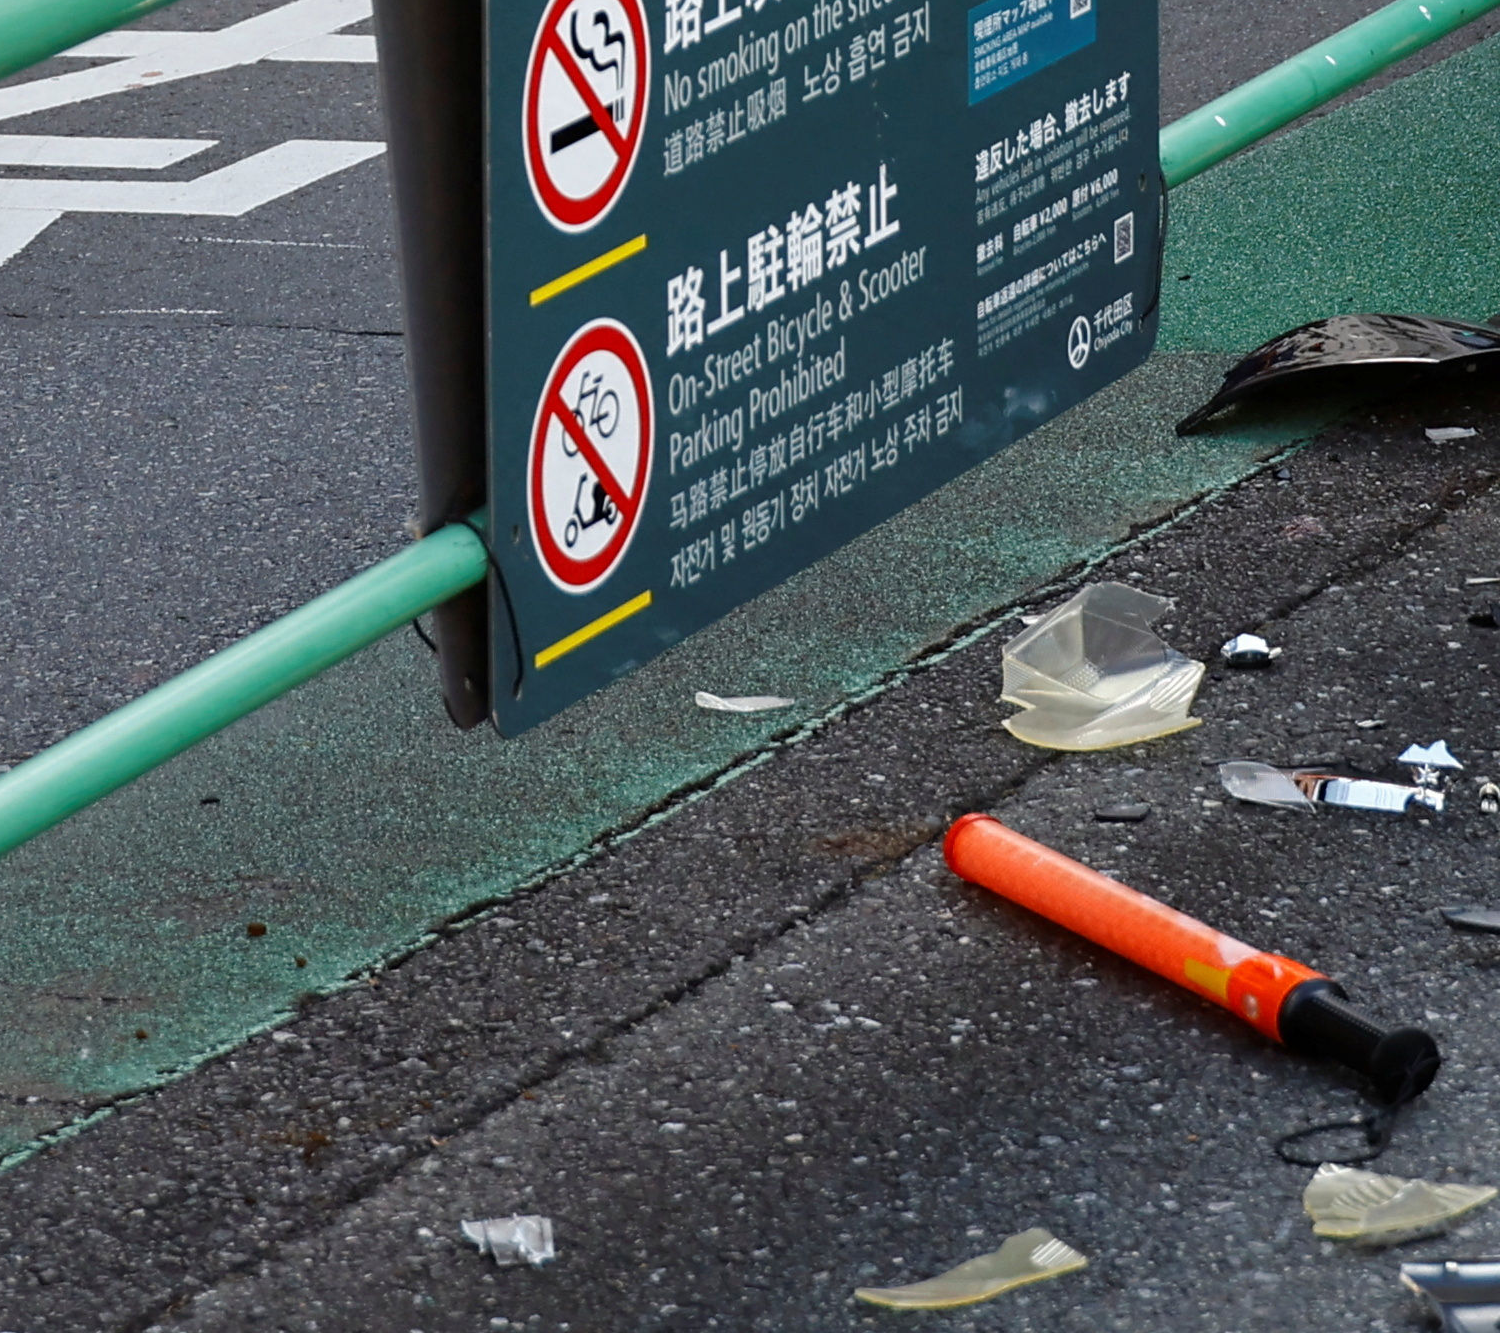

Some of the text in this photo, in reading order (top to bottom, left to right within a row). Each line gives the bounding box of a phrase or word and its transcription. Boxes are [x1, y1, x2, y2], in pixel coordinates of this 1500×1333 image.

[664, 70, 692, 116] No
[697, 31, 779, 99] smoking
[784, 16, 809, 54] on
[802, 47, 842, 102] 노상
[848, 24, 886, 81] 흡연
[892, 1, 930, 58] 금지
[664, 73, 787, 175] 道路禁止吸烟
[975, 72, 1130, 181] 違反した場合、撤去します
[667, 166, 899, 355] 路上駐輪禁止
[1093, 292, 1133, 333] 千代田区
[668, 246, 926, 416] On-Street Bicycle & Scooter
[669, 336, 845, 474] Parking Prohibited
[670, 339, 953, 527] 马路禁止停放自行车和小型摩托车
[670, 385, 962, 587] 자전거 및 원동기 장치 자전거 노상 주차 금지
